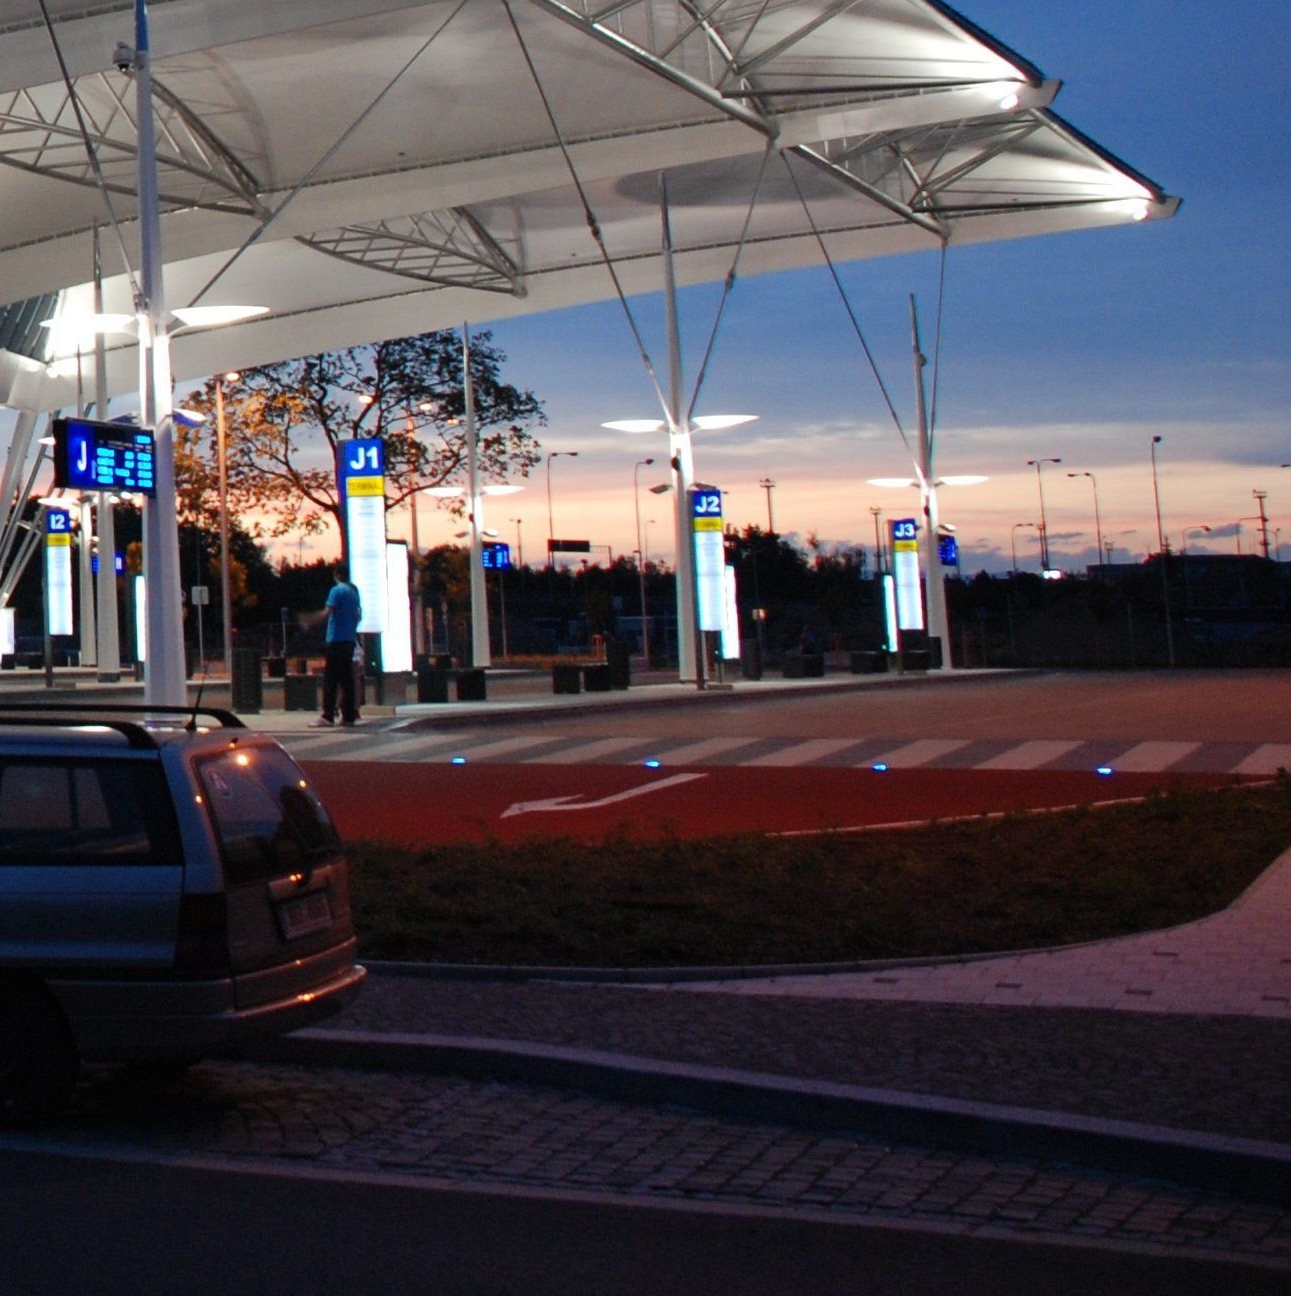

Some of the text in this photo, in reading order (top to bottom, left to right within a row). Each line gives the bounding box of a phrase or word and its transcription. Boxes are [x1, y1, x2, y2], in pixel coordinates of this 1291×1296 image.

[77, 440, 87, 471] J
[350, 446, 379, 470] J1
[695, 495, 720, 513] J2
[50, 514, 66, 529] I2
[895, 523, 914, 537] J3
